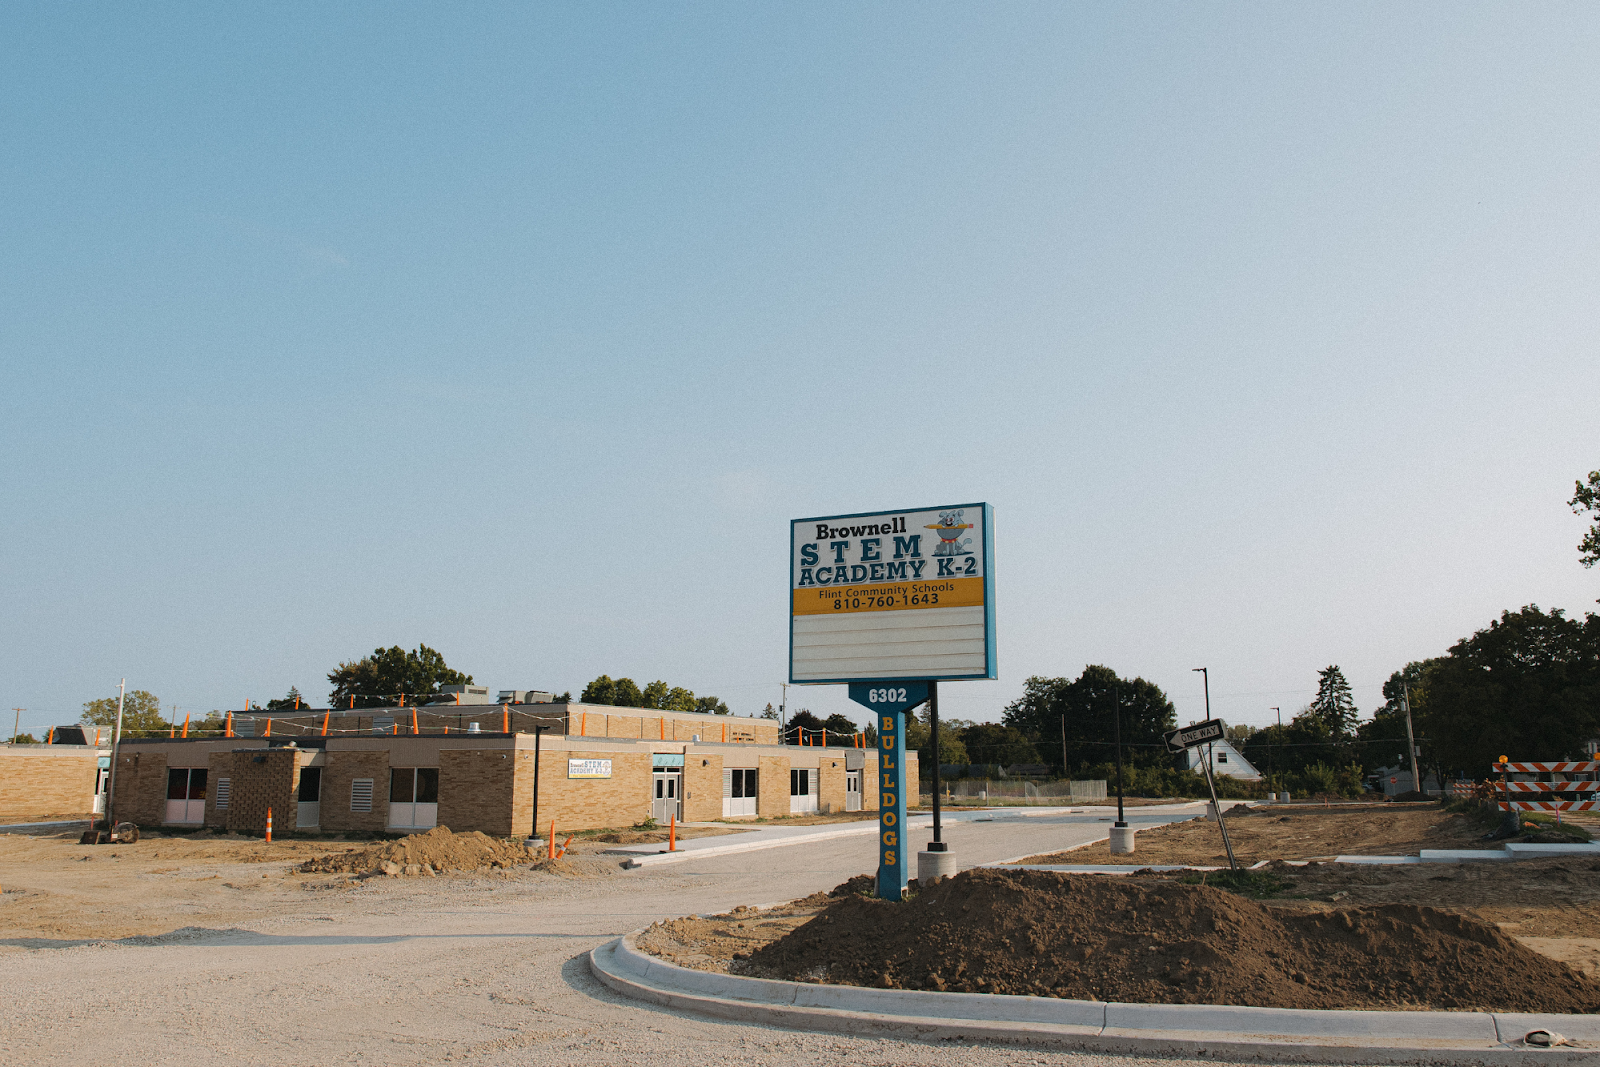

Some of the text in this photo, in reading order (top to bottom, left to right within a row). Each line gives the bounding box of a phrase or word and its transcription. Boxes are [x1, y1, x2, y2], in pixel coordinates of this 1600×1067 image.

[816, 517, 906, 540] Brownell
[801, 535, 921, 566] STEM
[799, 556, 977, 586] ACADEMY K-2
[819, 582, 954, 599] Flint Community Schools
[833, 593, 939, 610] 810-760-1643
[869, 688, 907, 703] 6302
[1181, 726, 1216, 742] ONE WAY
[882, 716, 898, 866] BULLDOGS
